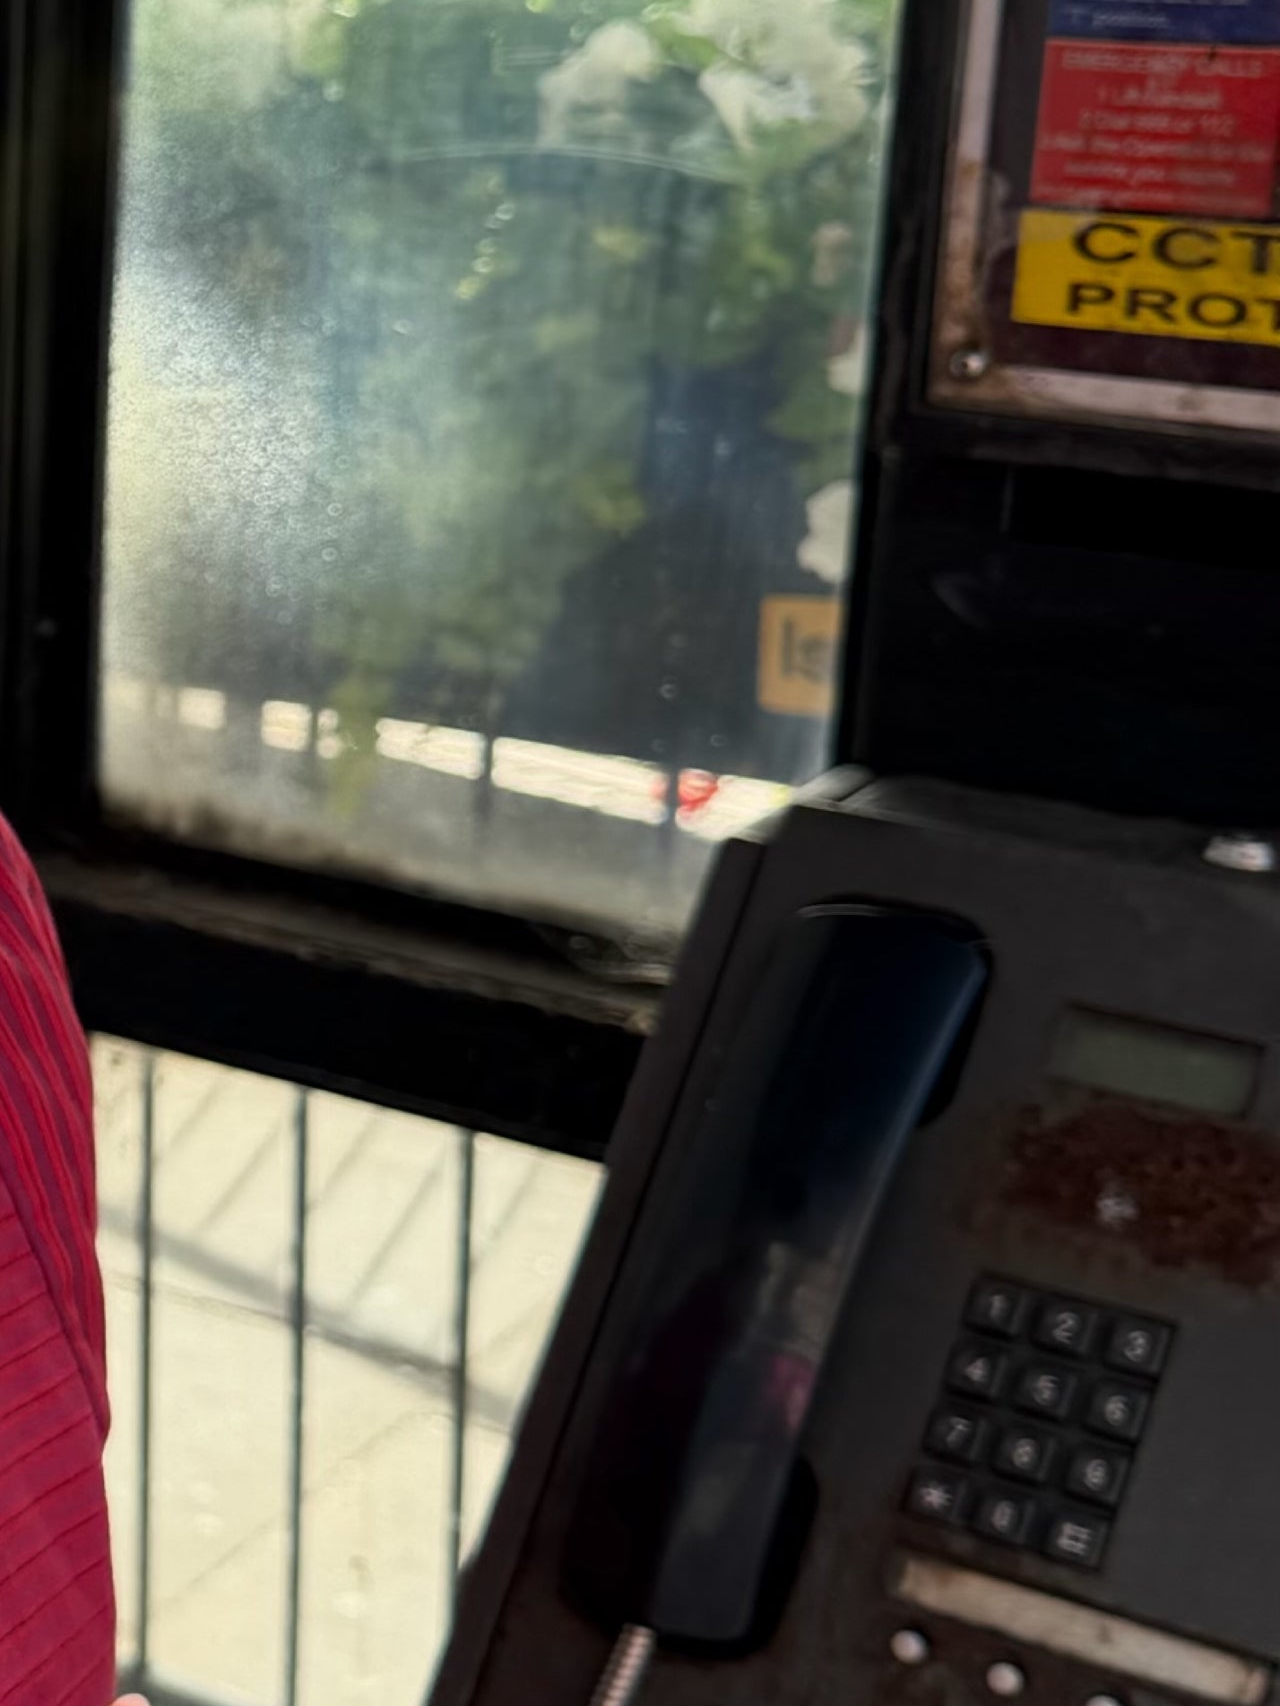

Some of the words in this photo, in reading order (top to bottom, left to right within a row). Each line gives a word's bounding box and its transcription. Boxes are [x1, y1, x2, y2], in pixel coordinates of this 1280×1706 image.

[1051, 1310, 1082, 1345] 2
[1122, 1329, 1152, 1364] 3
[962, 1356, 989, 1384] 4
[1031, 1374, 1061, 1408] 5
[1103, 1393, 1130, 1427] 6
[944, 1415, 972, 1447] 7
[1011, 1436, 1039, 1471] 8
